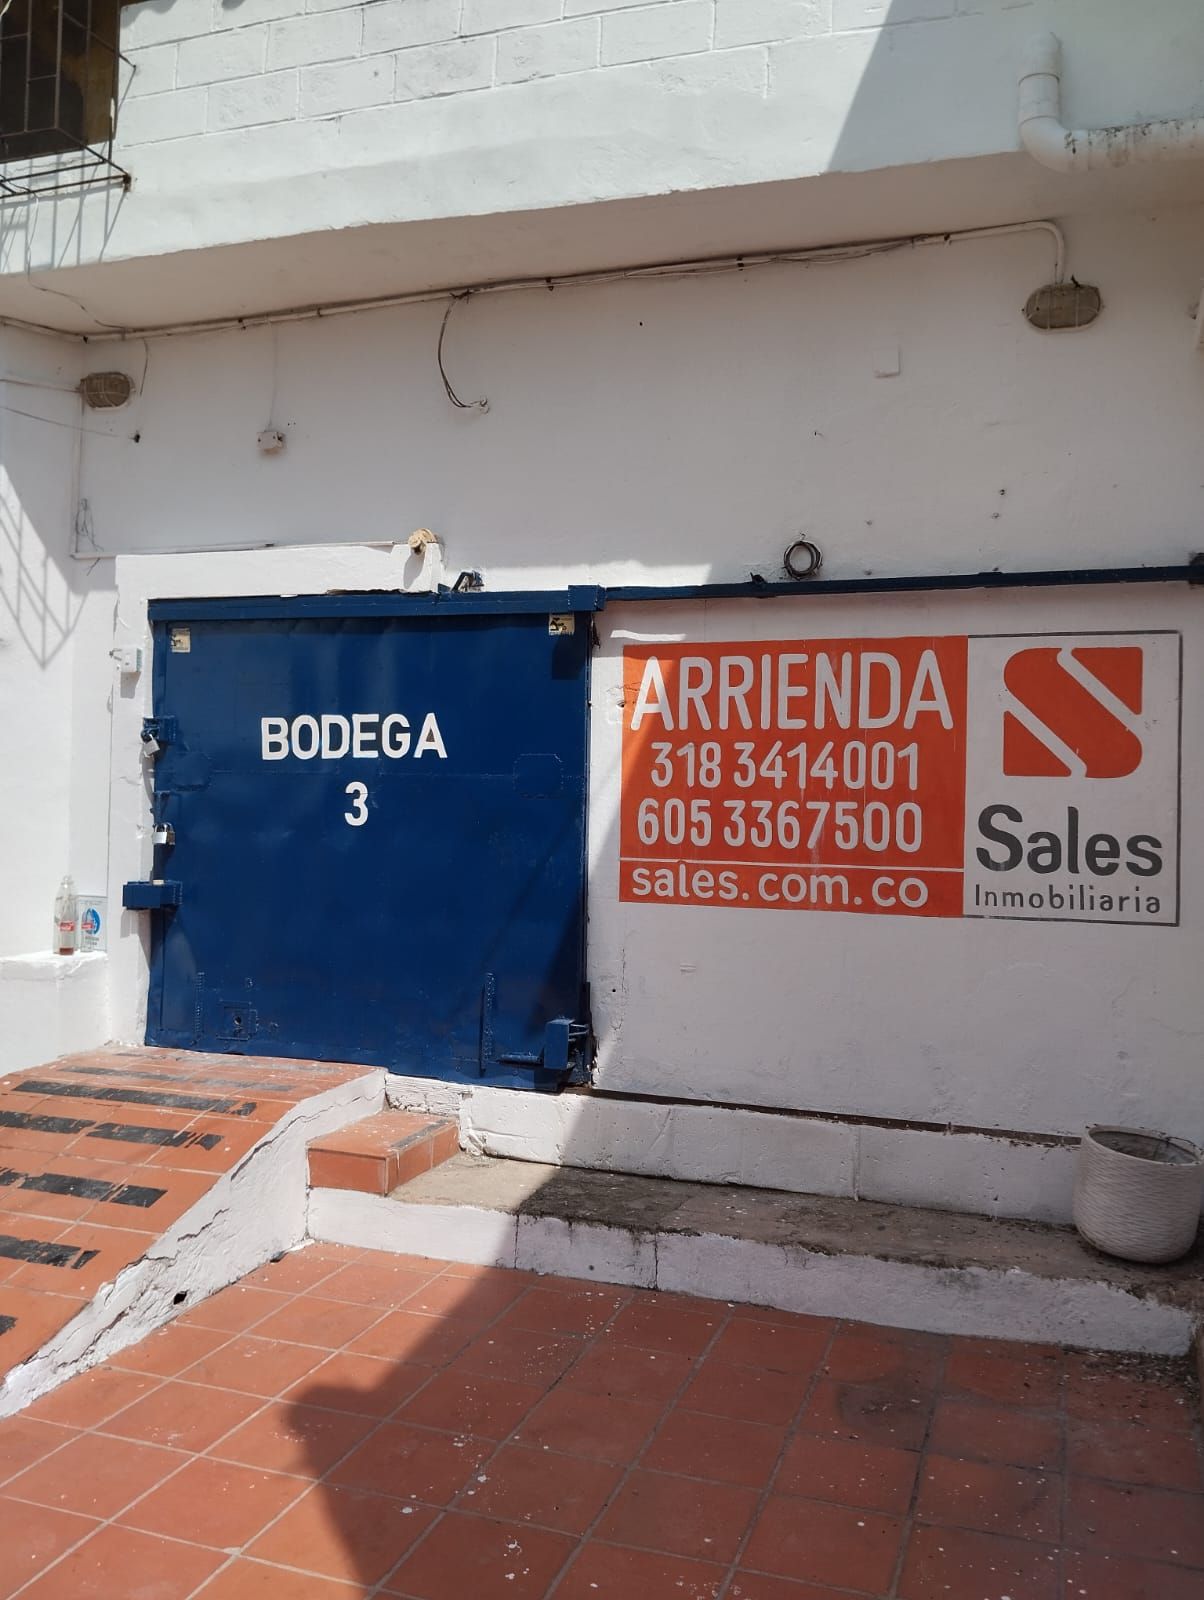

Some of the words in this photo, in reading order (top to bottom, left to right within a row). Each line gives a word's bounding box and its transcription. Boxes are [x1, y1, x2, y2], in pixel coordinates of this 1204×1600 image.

[631, 648, 953, 731] ARRIENDA
[261, 712, 448, 761] BODEGA
[650, 741, 722, 788] 318
[733, 740, 919, 791] 3414001
[344, 781, 369, 827] 3
[637, 797, 712, 847] 605
[723, 799, 923, 853] 3367500
[976, 803, 1163, 877] Sales
[974, 883, 1161, 914] Inmobiliaria
